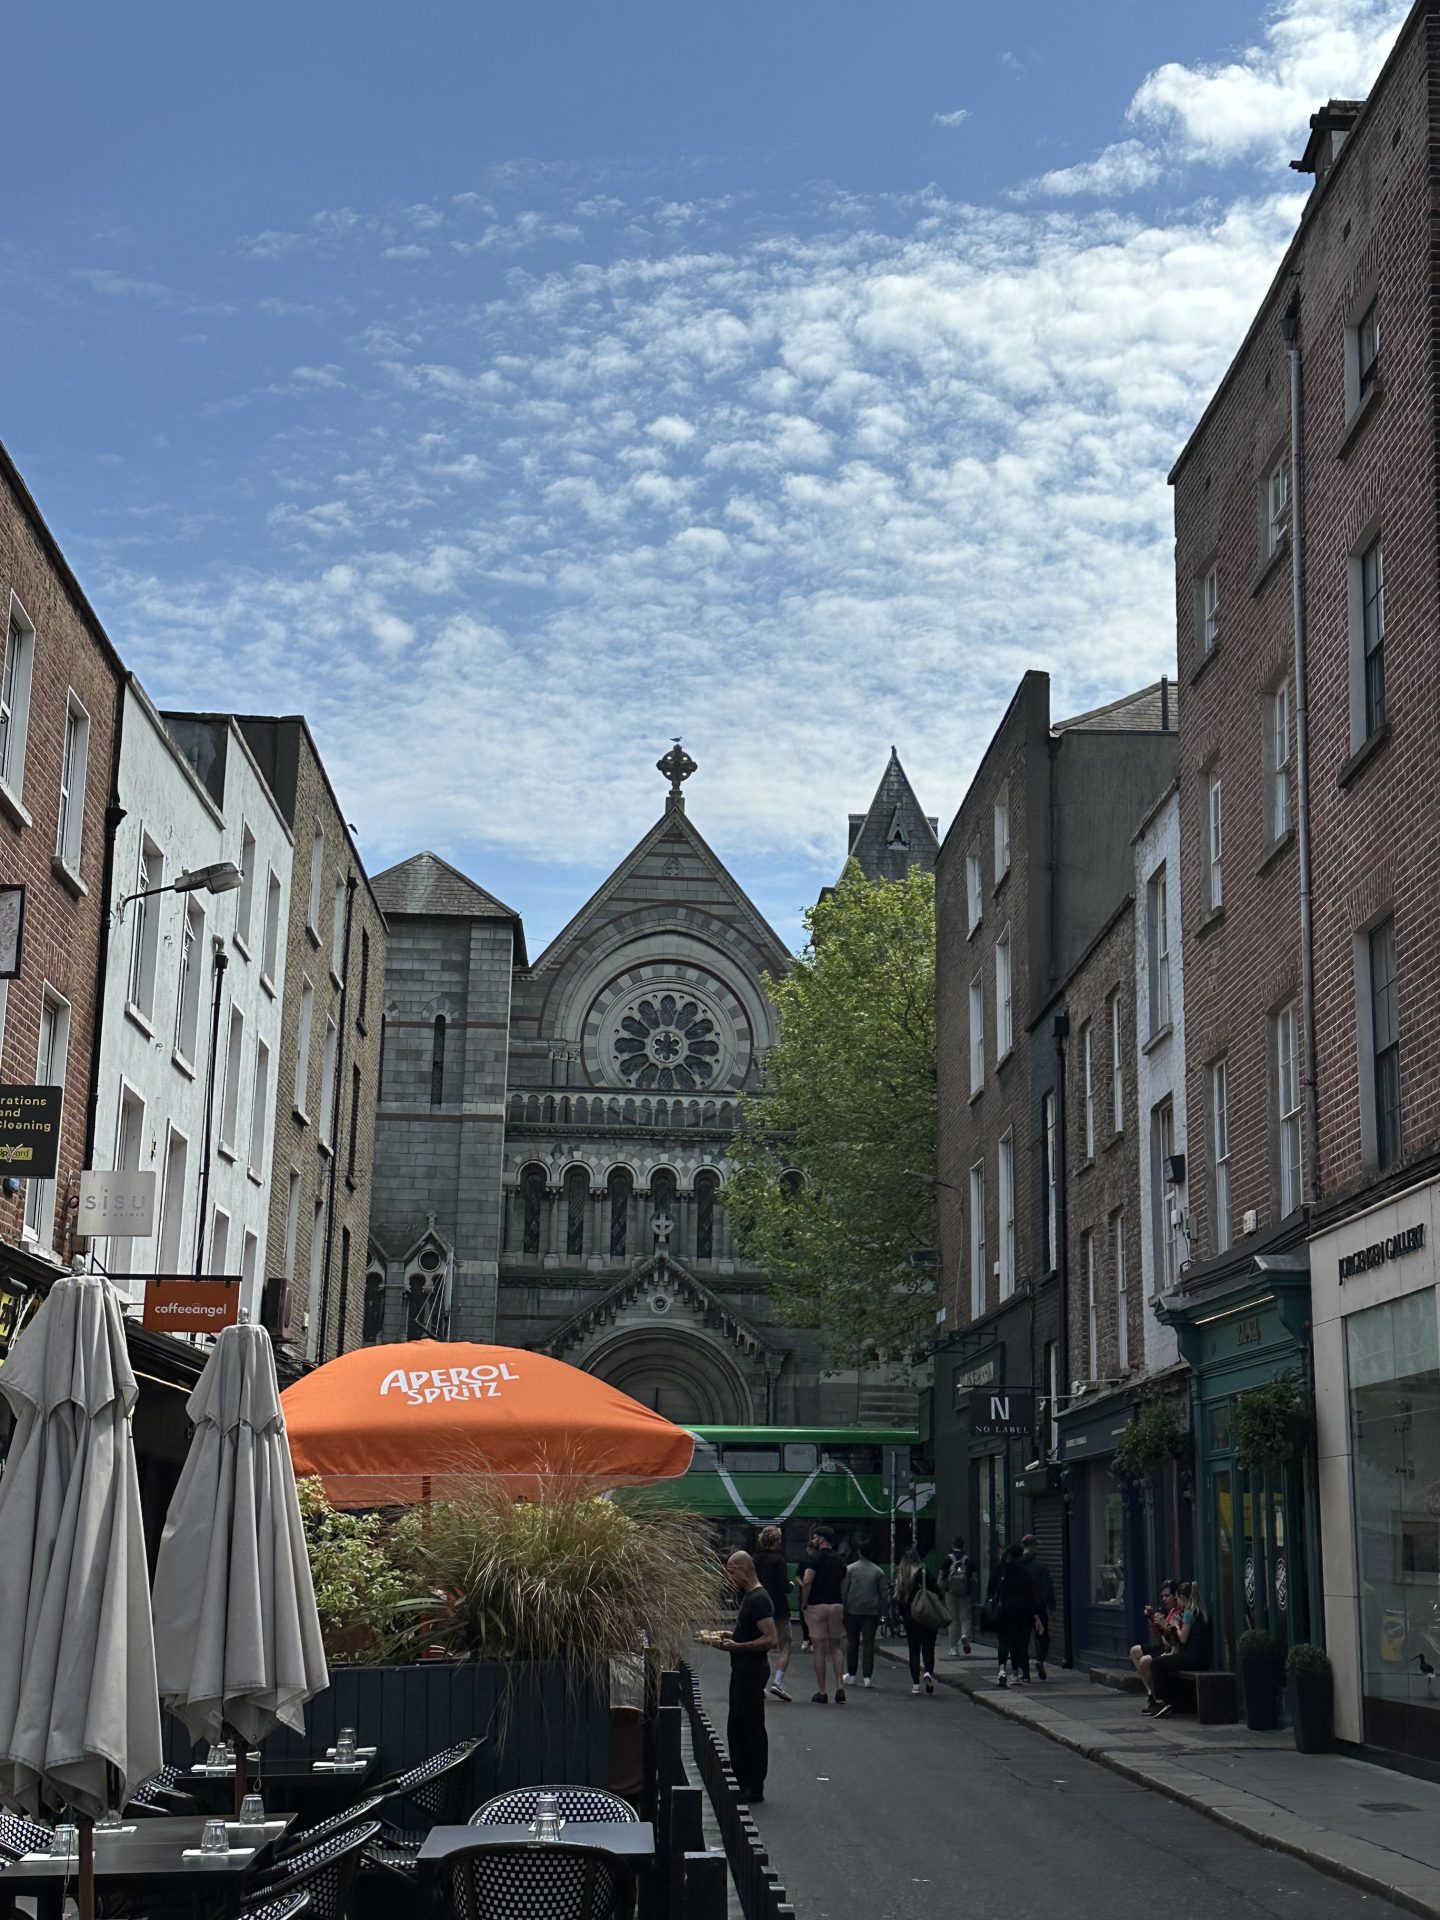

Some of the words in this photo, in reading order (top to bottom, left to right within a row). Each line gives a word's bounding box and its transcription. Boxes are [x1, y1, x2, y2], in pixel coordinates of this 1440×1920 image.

[0, 1096, 47, 1106] rations
[1385, 1223, 1424, 1260] GALLERY
[155, 1302, 227, 1317] coffeeangel
[380, 1363, 520, 1394] APEROL
[990, 1396, 1010, 1420] N
[975, 1425, 990, 1433] NO
[995, 1425, 1029, 1434] LABEL
